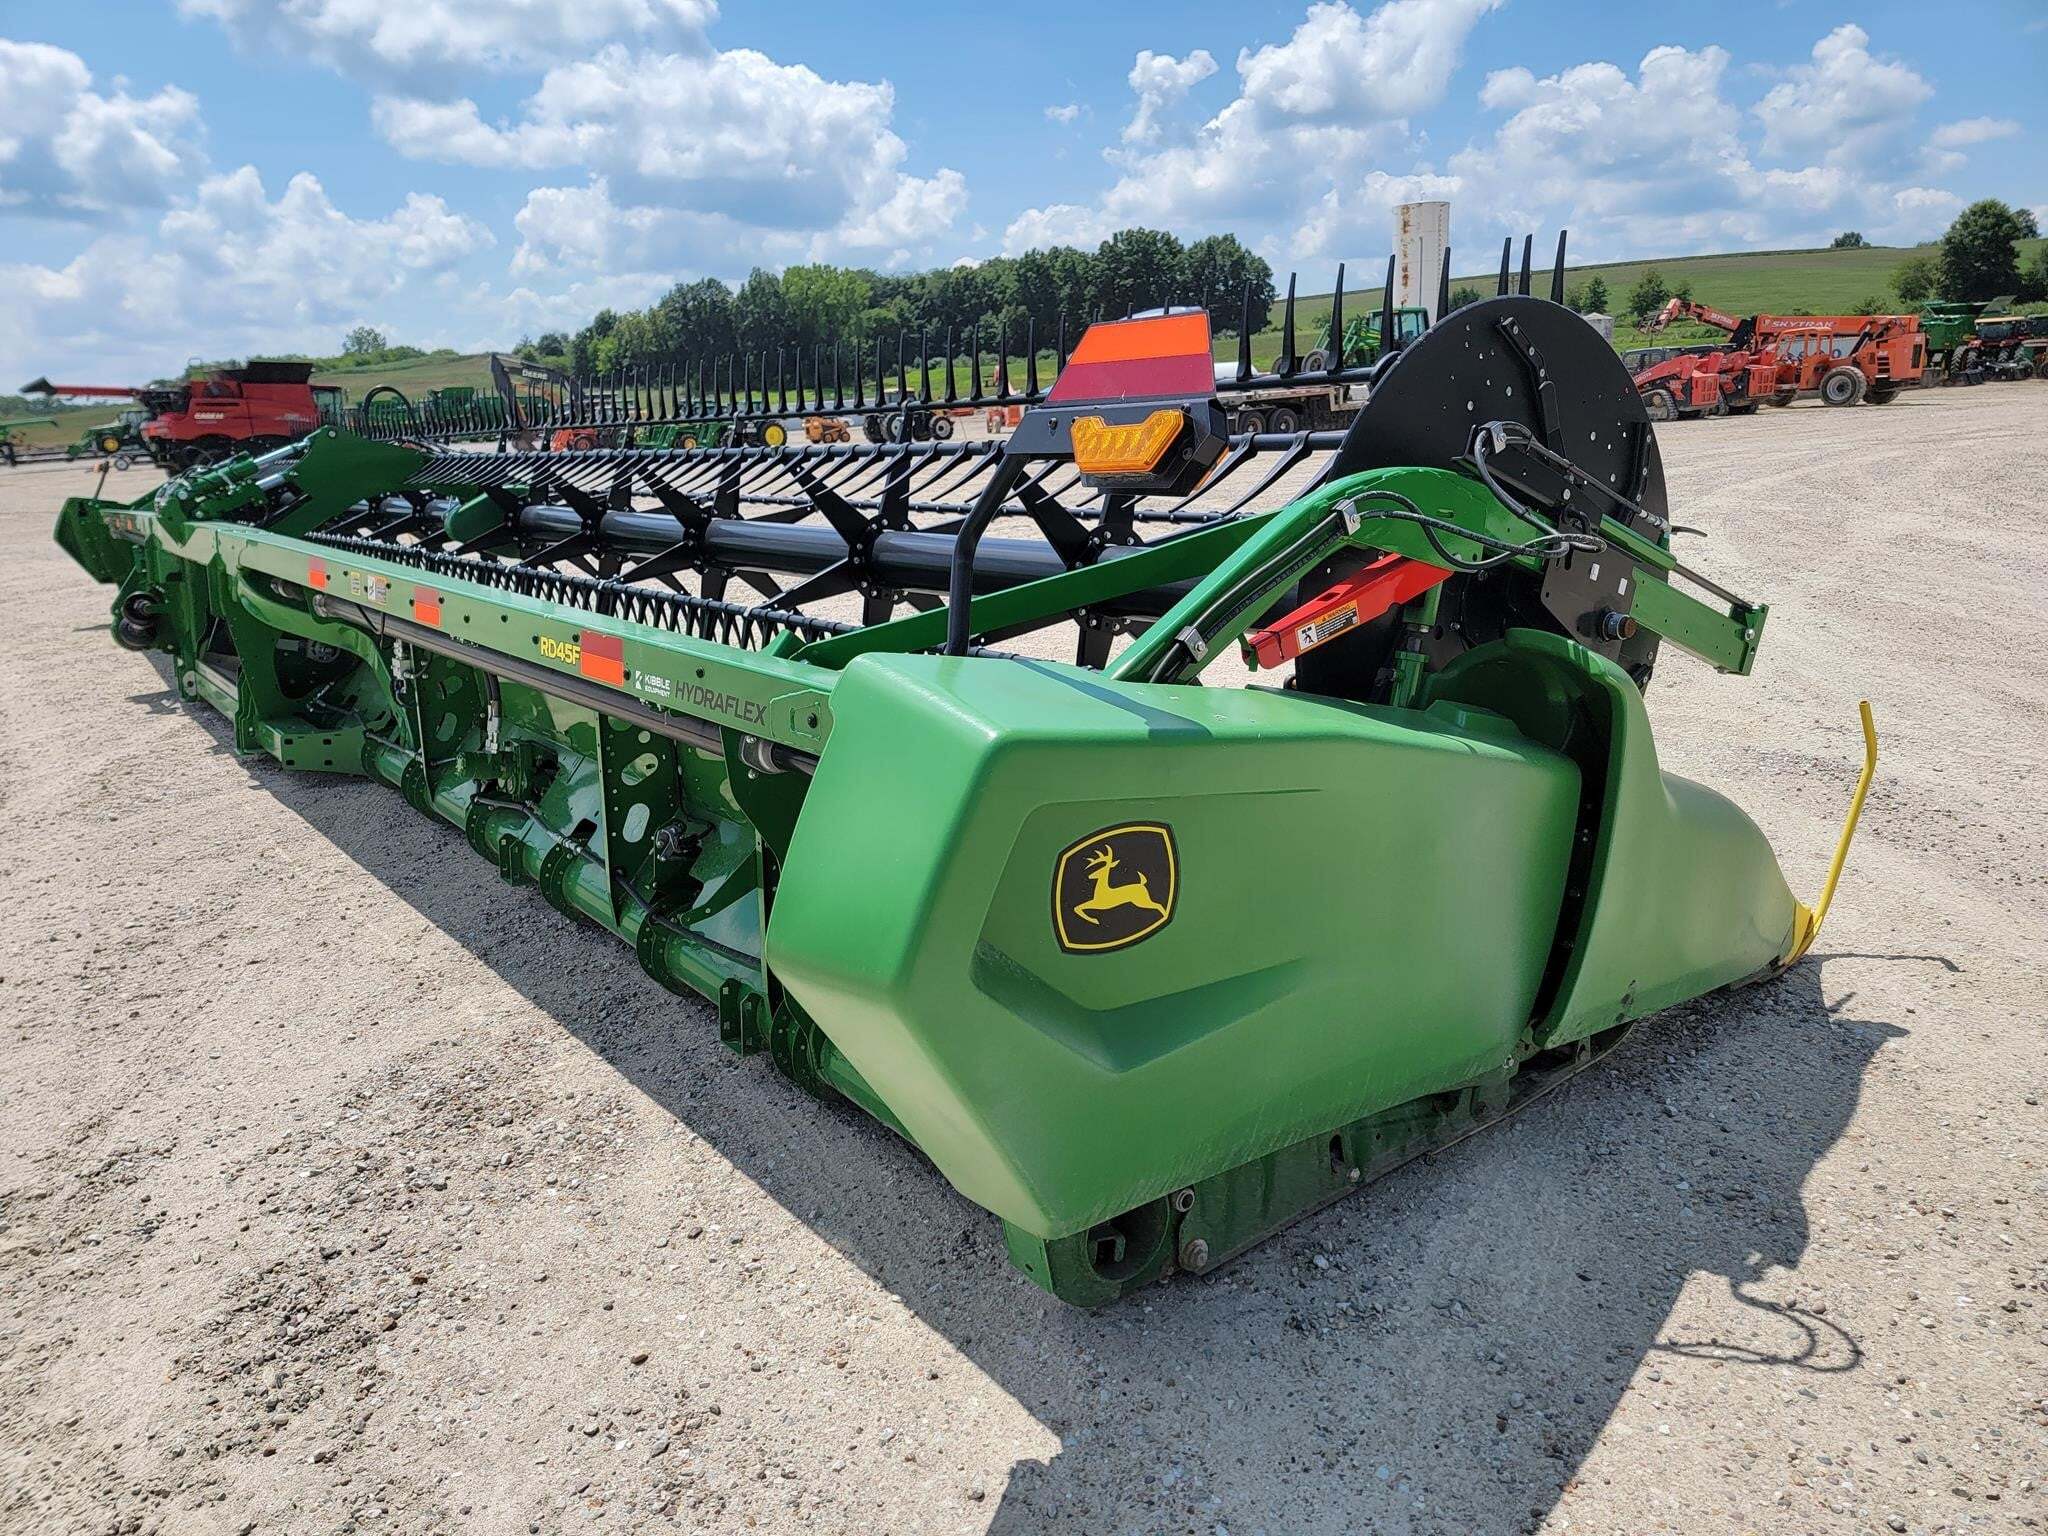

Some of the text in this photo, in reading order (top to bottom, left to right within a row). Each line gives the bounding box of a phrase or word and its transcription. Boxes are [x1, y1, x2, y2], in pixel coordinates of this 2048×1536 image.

[1772, 320, 1834, 328] SKYTRAK
[522, 368, 548, 380] DEERE
[541, 636, 580, 665] RD45F
[645, 674, 670, 690] KIBBLE
[645, 685, 670, 698] EQUIPMENT
[675, 680, 767, 727] HYDRAFLEX
